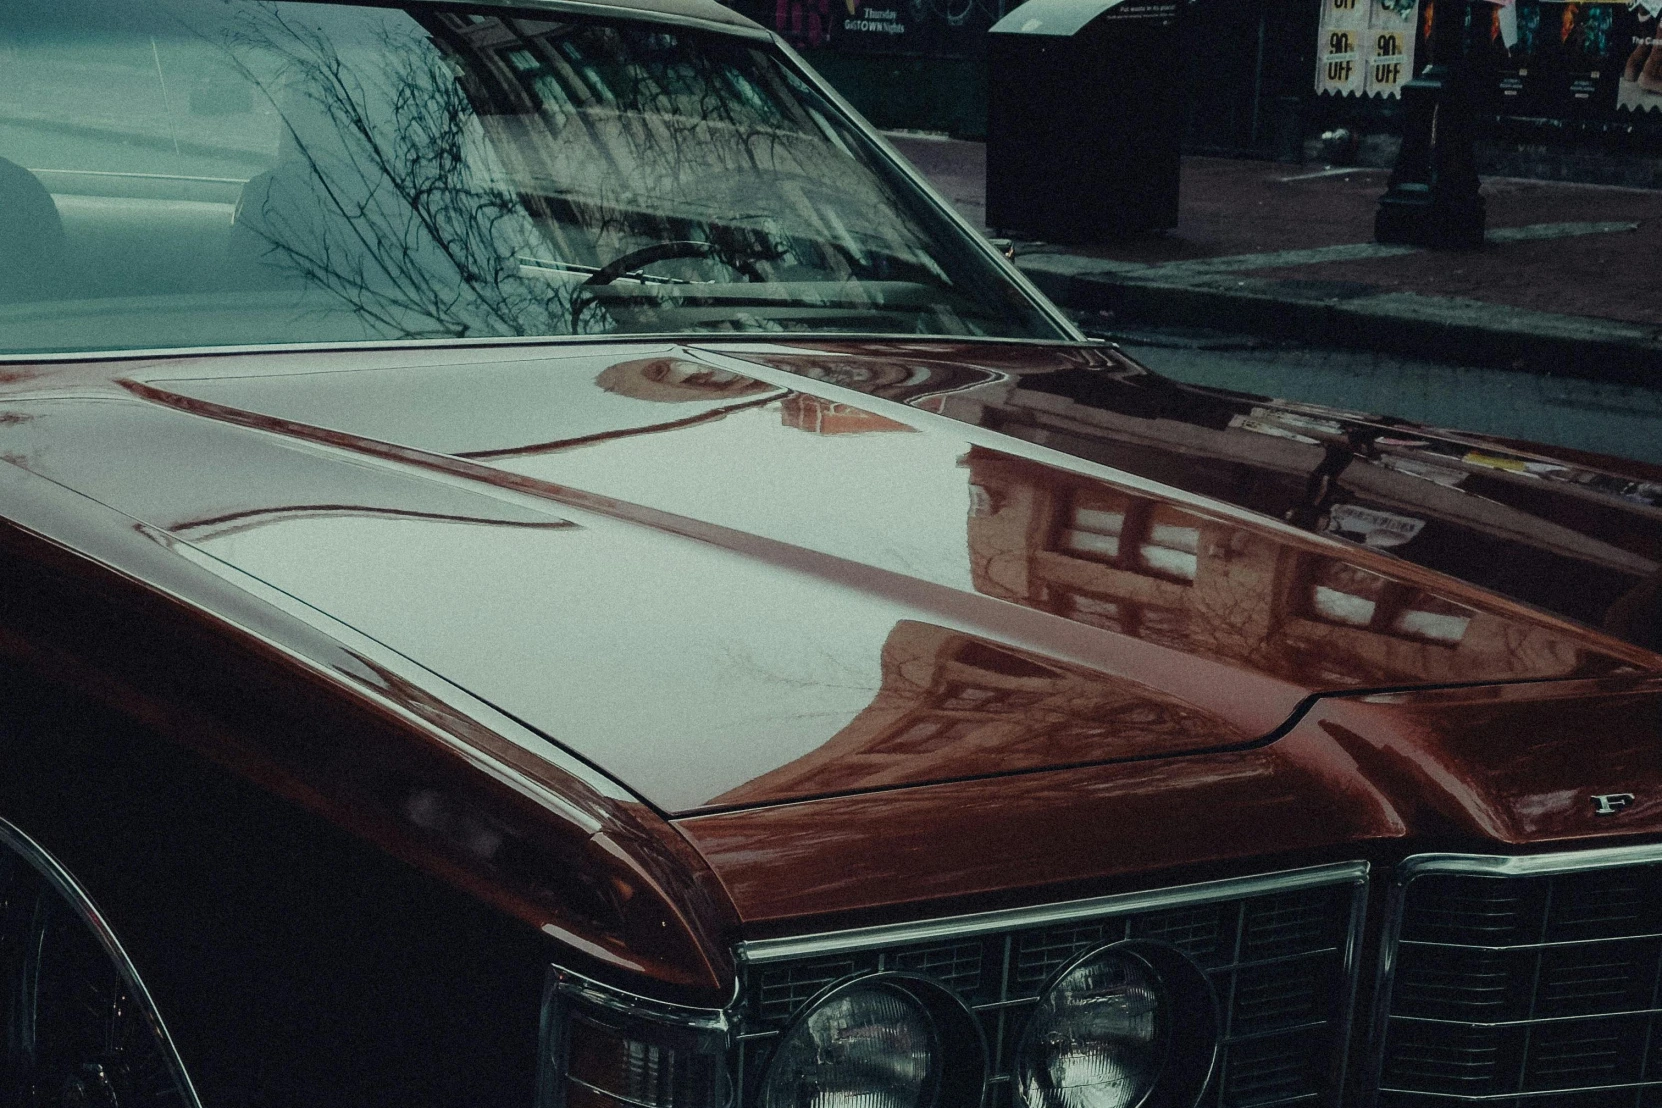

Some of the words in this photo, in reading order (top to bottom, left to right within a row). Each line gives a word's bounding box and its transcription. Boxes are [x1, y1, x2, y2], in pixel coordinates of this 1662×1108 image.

[863, 8, 897, 20] Thursday
[1328, 60, 1352, 80] OFF
[1375, 62, 1400, 83] OFF
